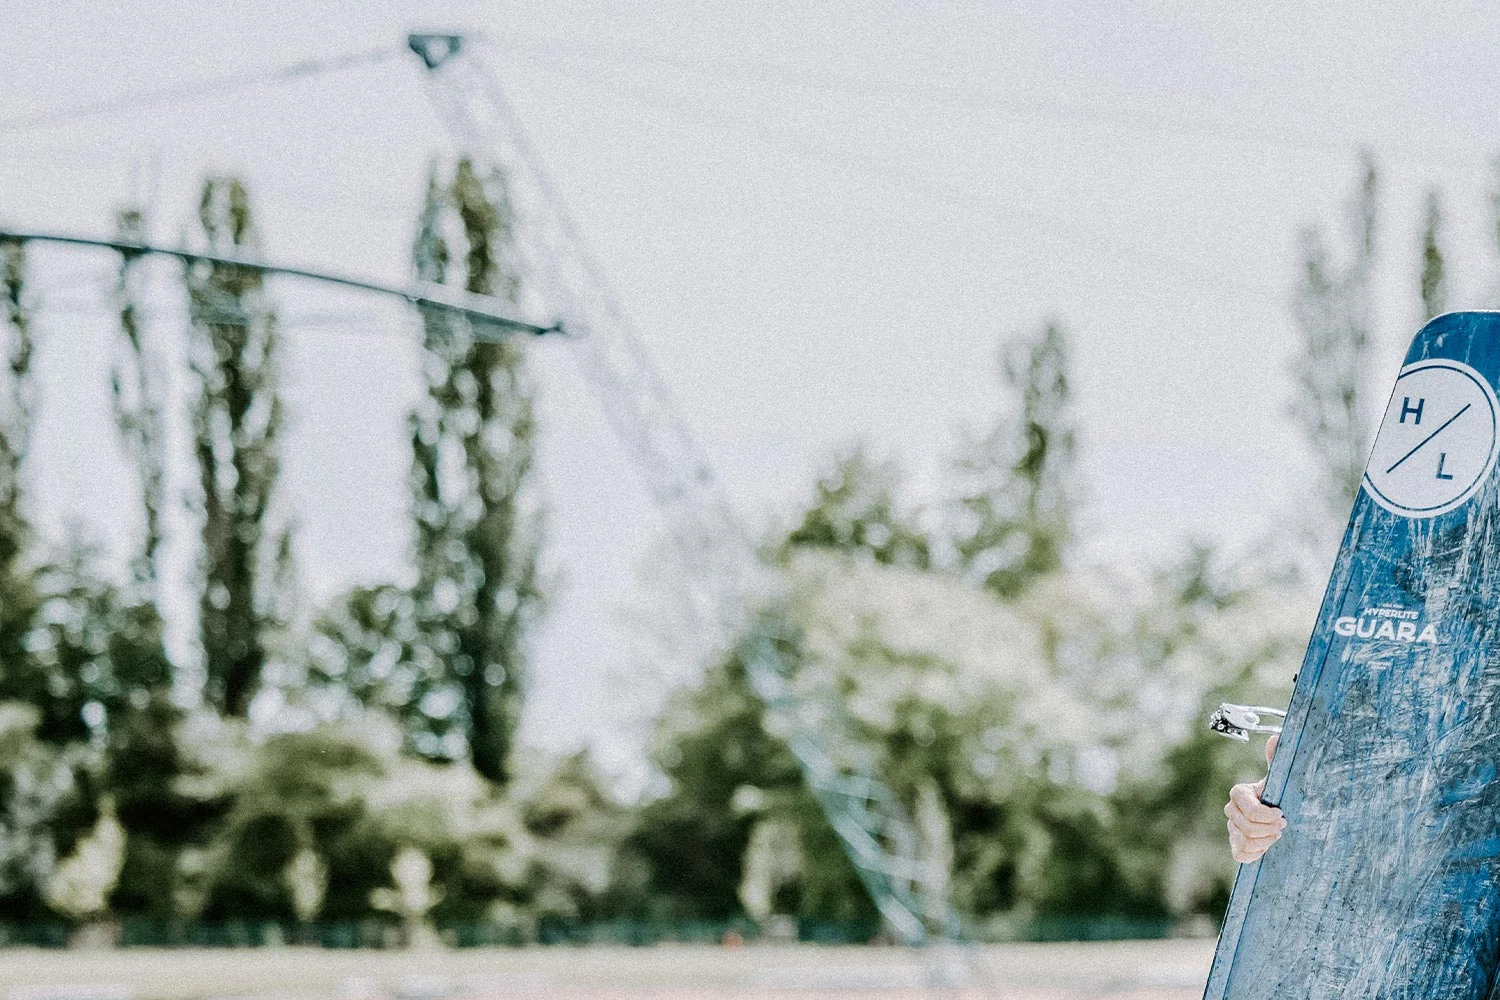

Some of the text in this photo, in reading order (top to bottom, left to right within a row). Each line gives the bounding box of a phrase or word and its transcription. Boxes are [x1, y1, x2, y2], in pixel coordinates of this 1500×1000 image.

[1400, 397, 1425, 425] H
[1436, 452, 1454, 480] L
[1363, 607, 1419, 620] HYPERLITE
[1334, 616, 1437, 644] GUARA
